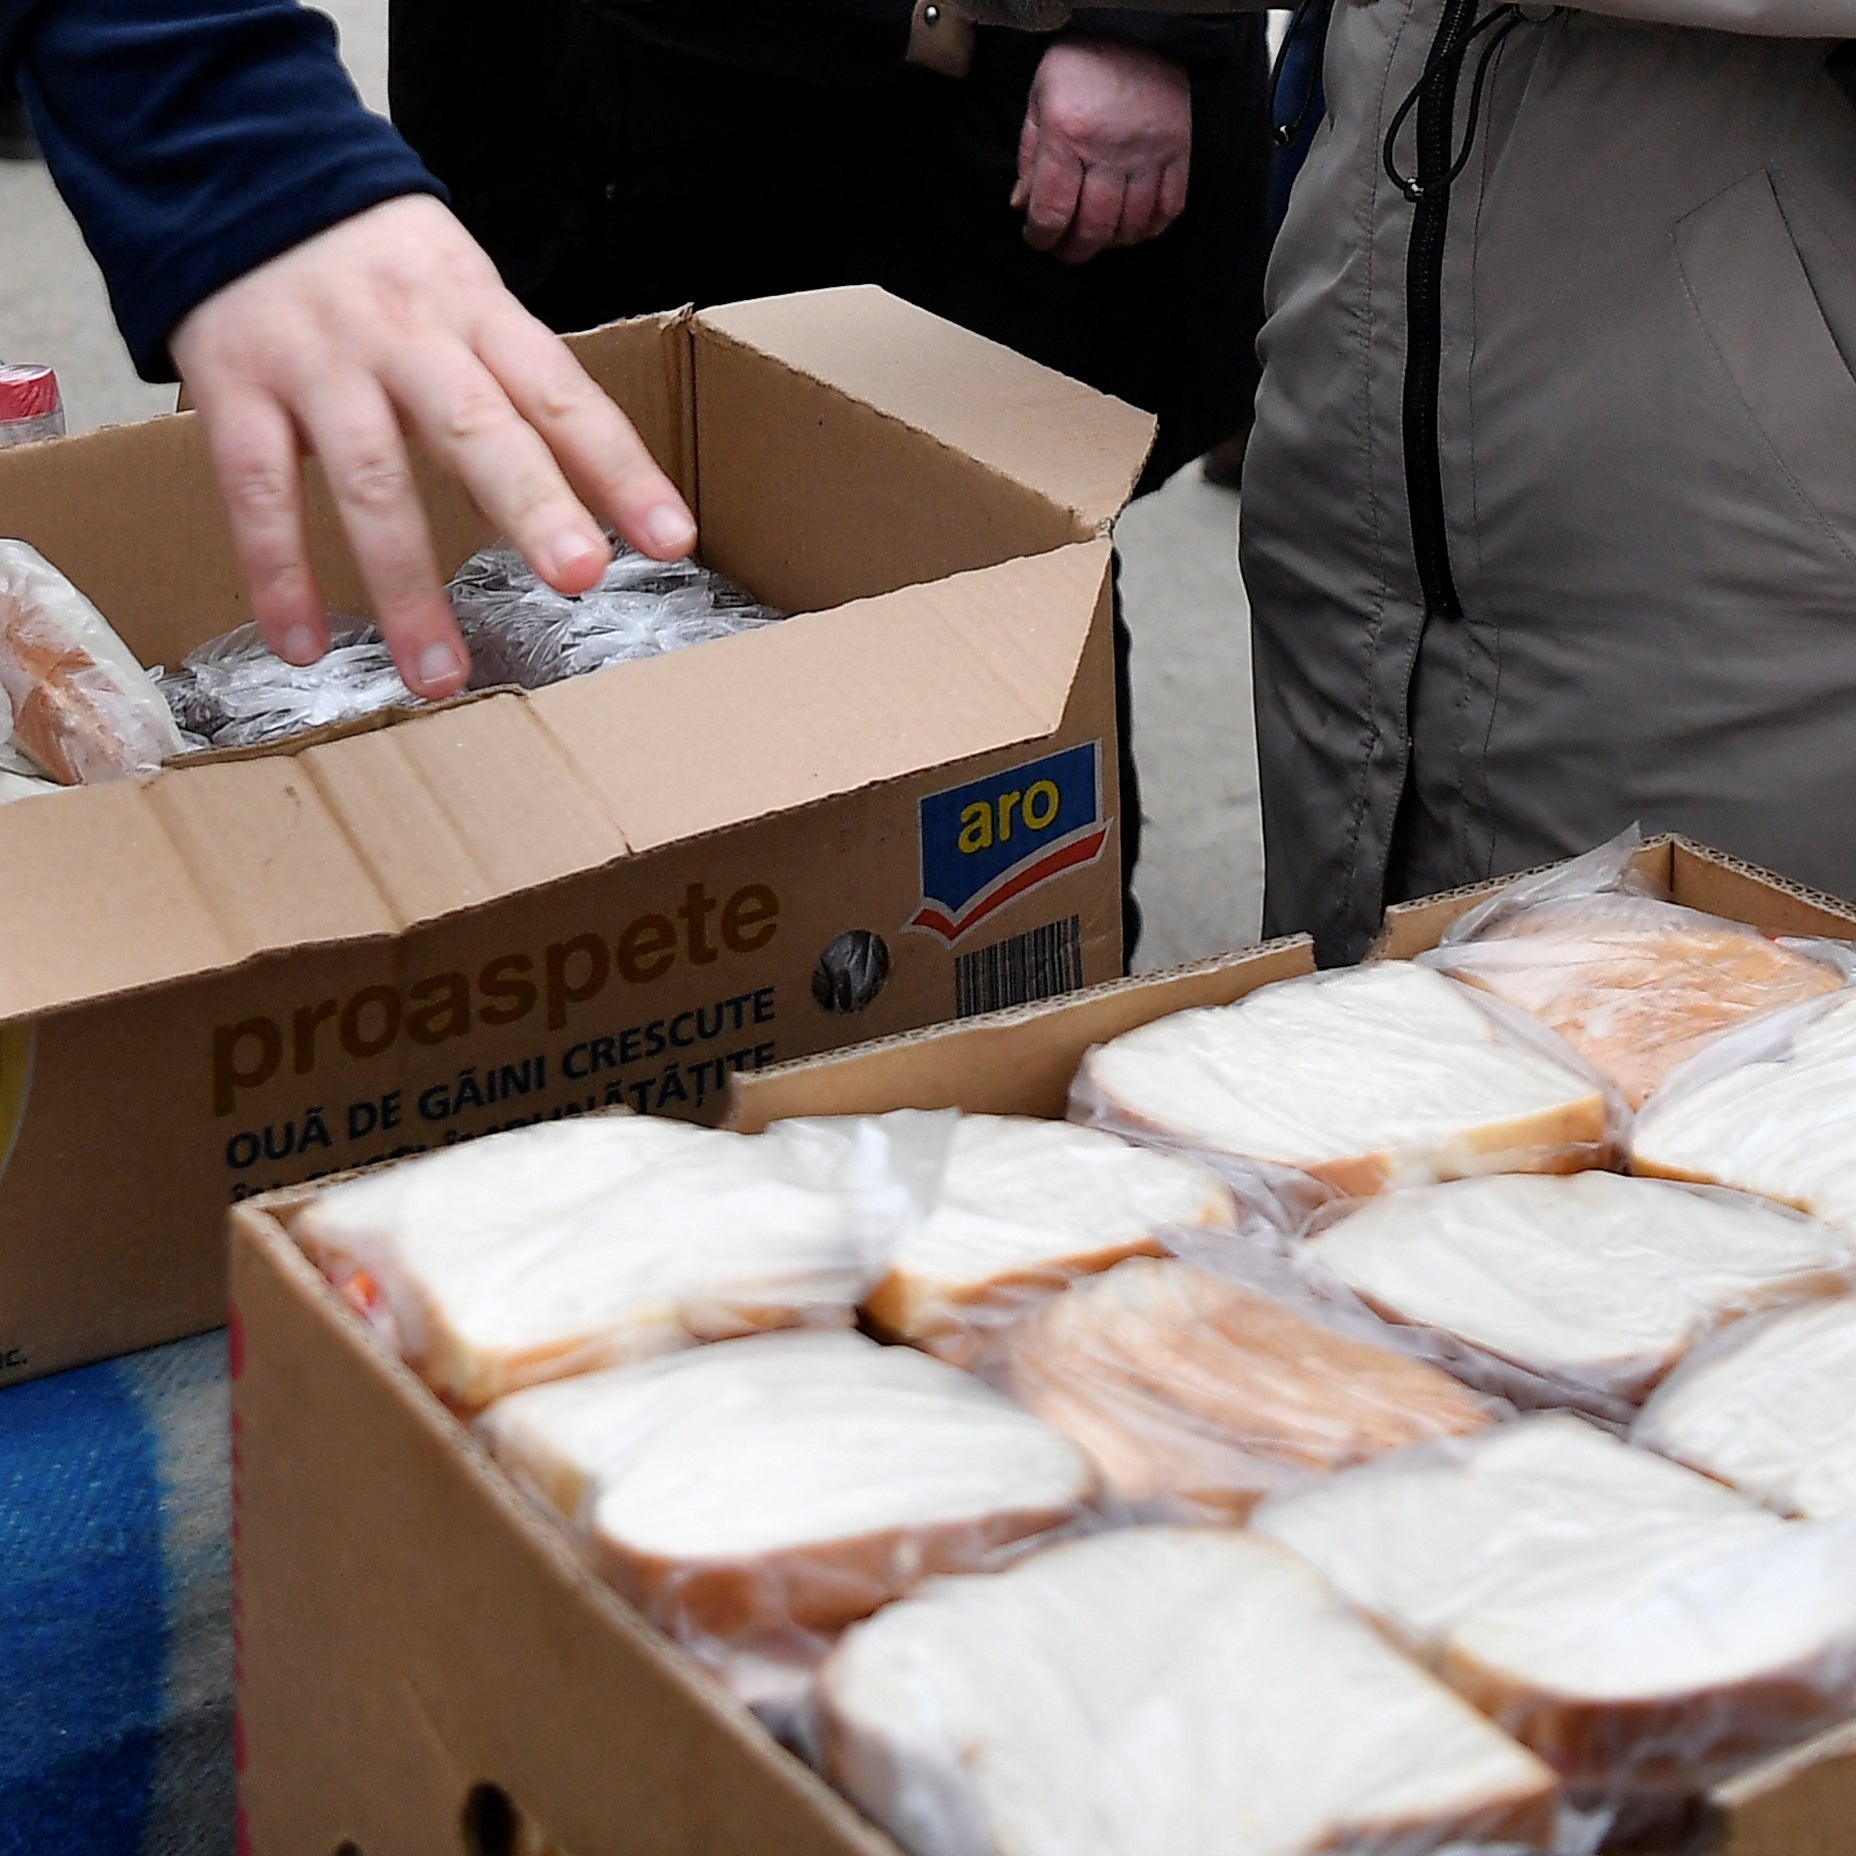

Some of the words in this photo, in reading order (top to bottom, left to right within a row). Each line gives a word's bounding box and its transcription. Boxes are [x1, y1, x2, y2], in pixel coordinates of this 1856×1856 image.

[957, 778, 1061, 855] aro
[212, 881, 781, 1117] proaspete
[347, 1090, 402, 1140] DE
[562, 986, 776, 1080] CRESCUTE
